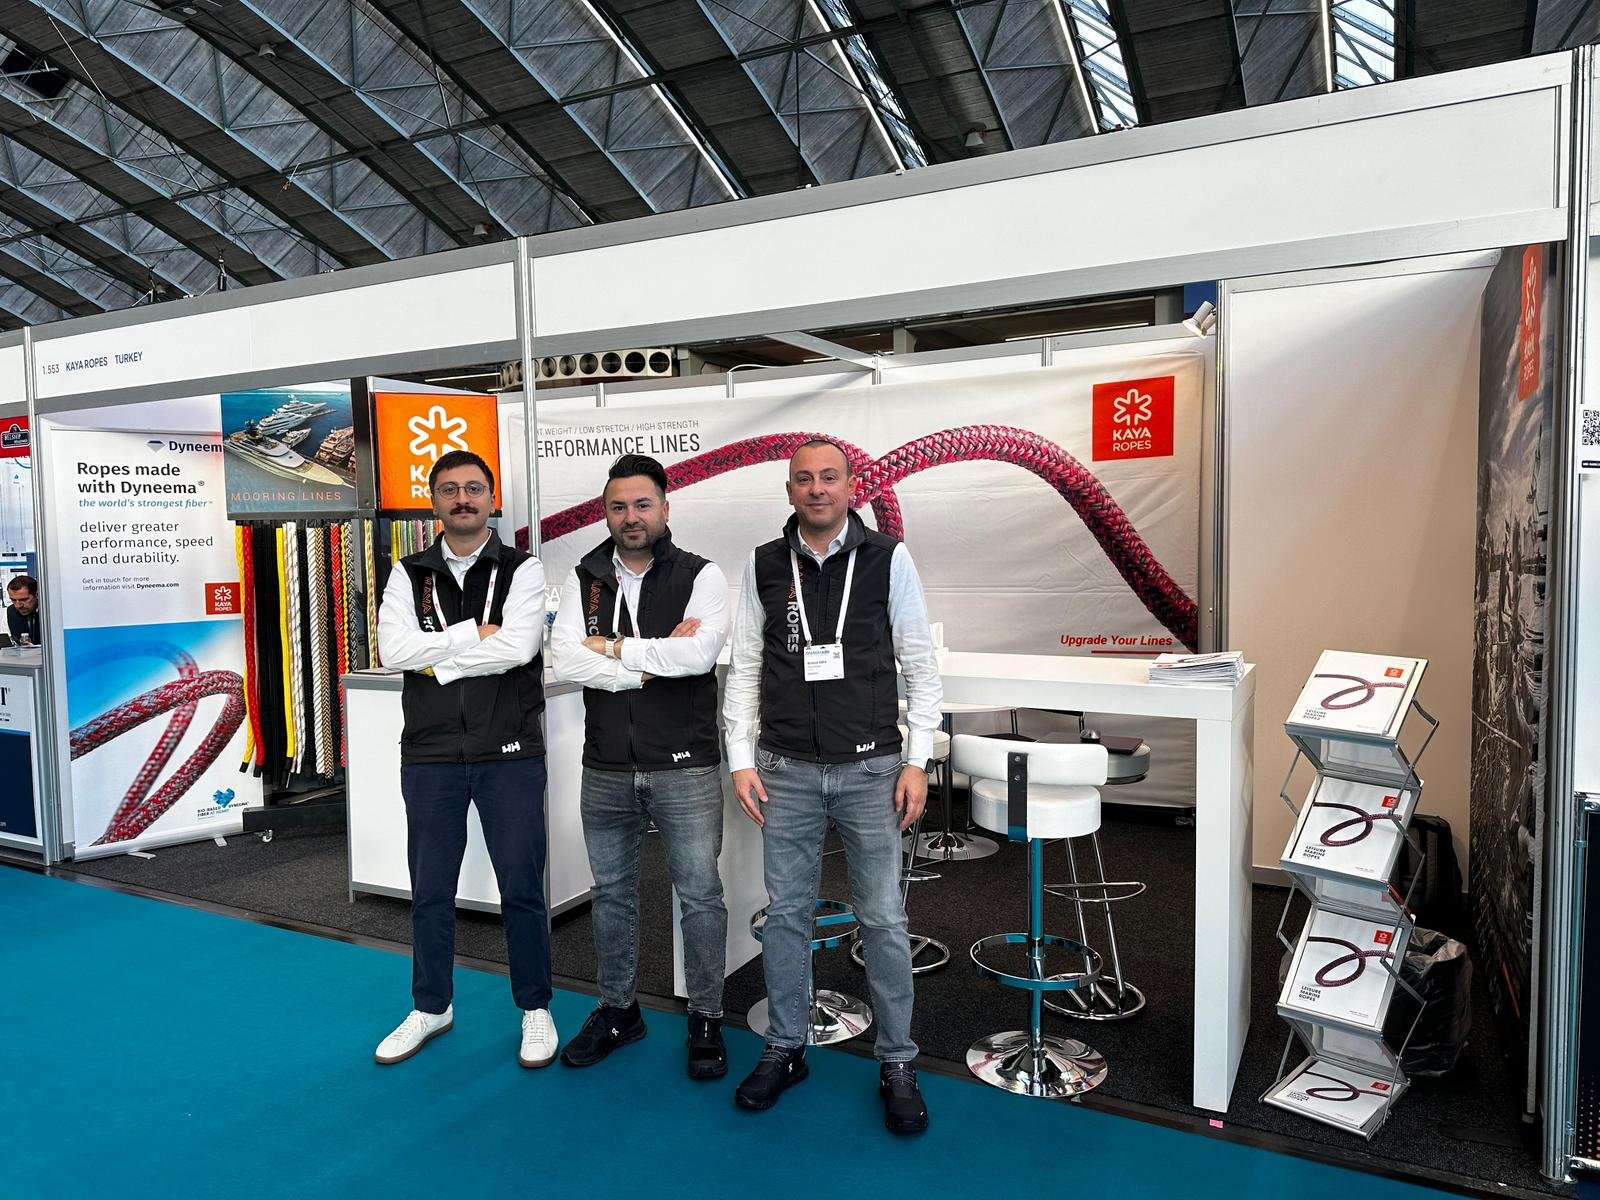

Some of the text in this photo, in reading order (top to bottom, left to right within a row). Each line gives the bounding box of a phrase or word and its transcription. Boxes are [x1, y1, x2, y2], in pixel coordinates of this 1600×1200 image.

[42, 364, 60, 374] 1.553
[114, 352, 142, 364] TURKEY
[545, 427, 572, 436] WEIGHT
[578, 426, 594, 434] LOW
[596, 424, 630, 433] STRETCH
[637, 422, 656, 431] HIGH
[657, 420, 699, 430] STRENGTH
[1113, 427, 1151, 440] KAYA
[169, 440, 222, 453] Dyneem
[537, 434, 700, 458] ERFORMANCE LINES
[1113, 440, 1152, 451] ROPES
[77, 462, 180, 478] Ropes made
[78, 480, 115, 493] with
[231, 492, 341, 500] MOORING LINES
[79, 499, 96, 507] the
[98, 499, 135, 507] world's
[138, 500, 183, 509] strongest
[80, 521, 179, 534] deliver greater
[81, 536, 213, 551] performance, speed
[82, 552, 179, 565] and durability.
[786, 601, 800, 653] ROPES
[1060, 635, 1172, 647] Upgrade Your Lines
[1300, 990, 1320, 998] MARINE
[1301, 985, 1321, 994] LEISURE
